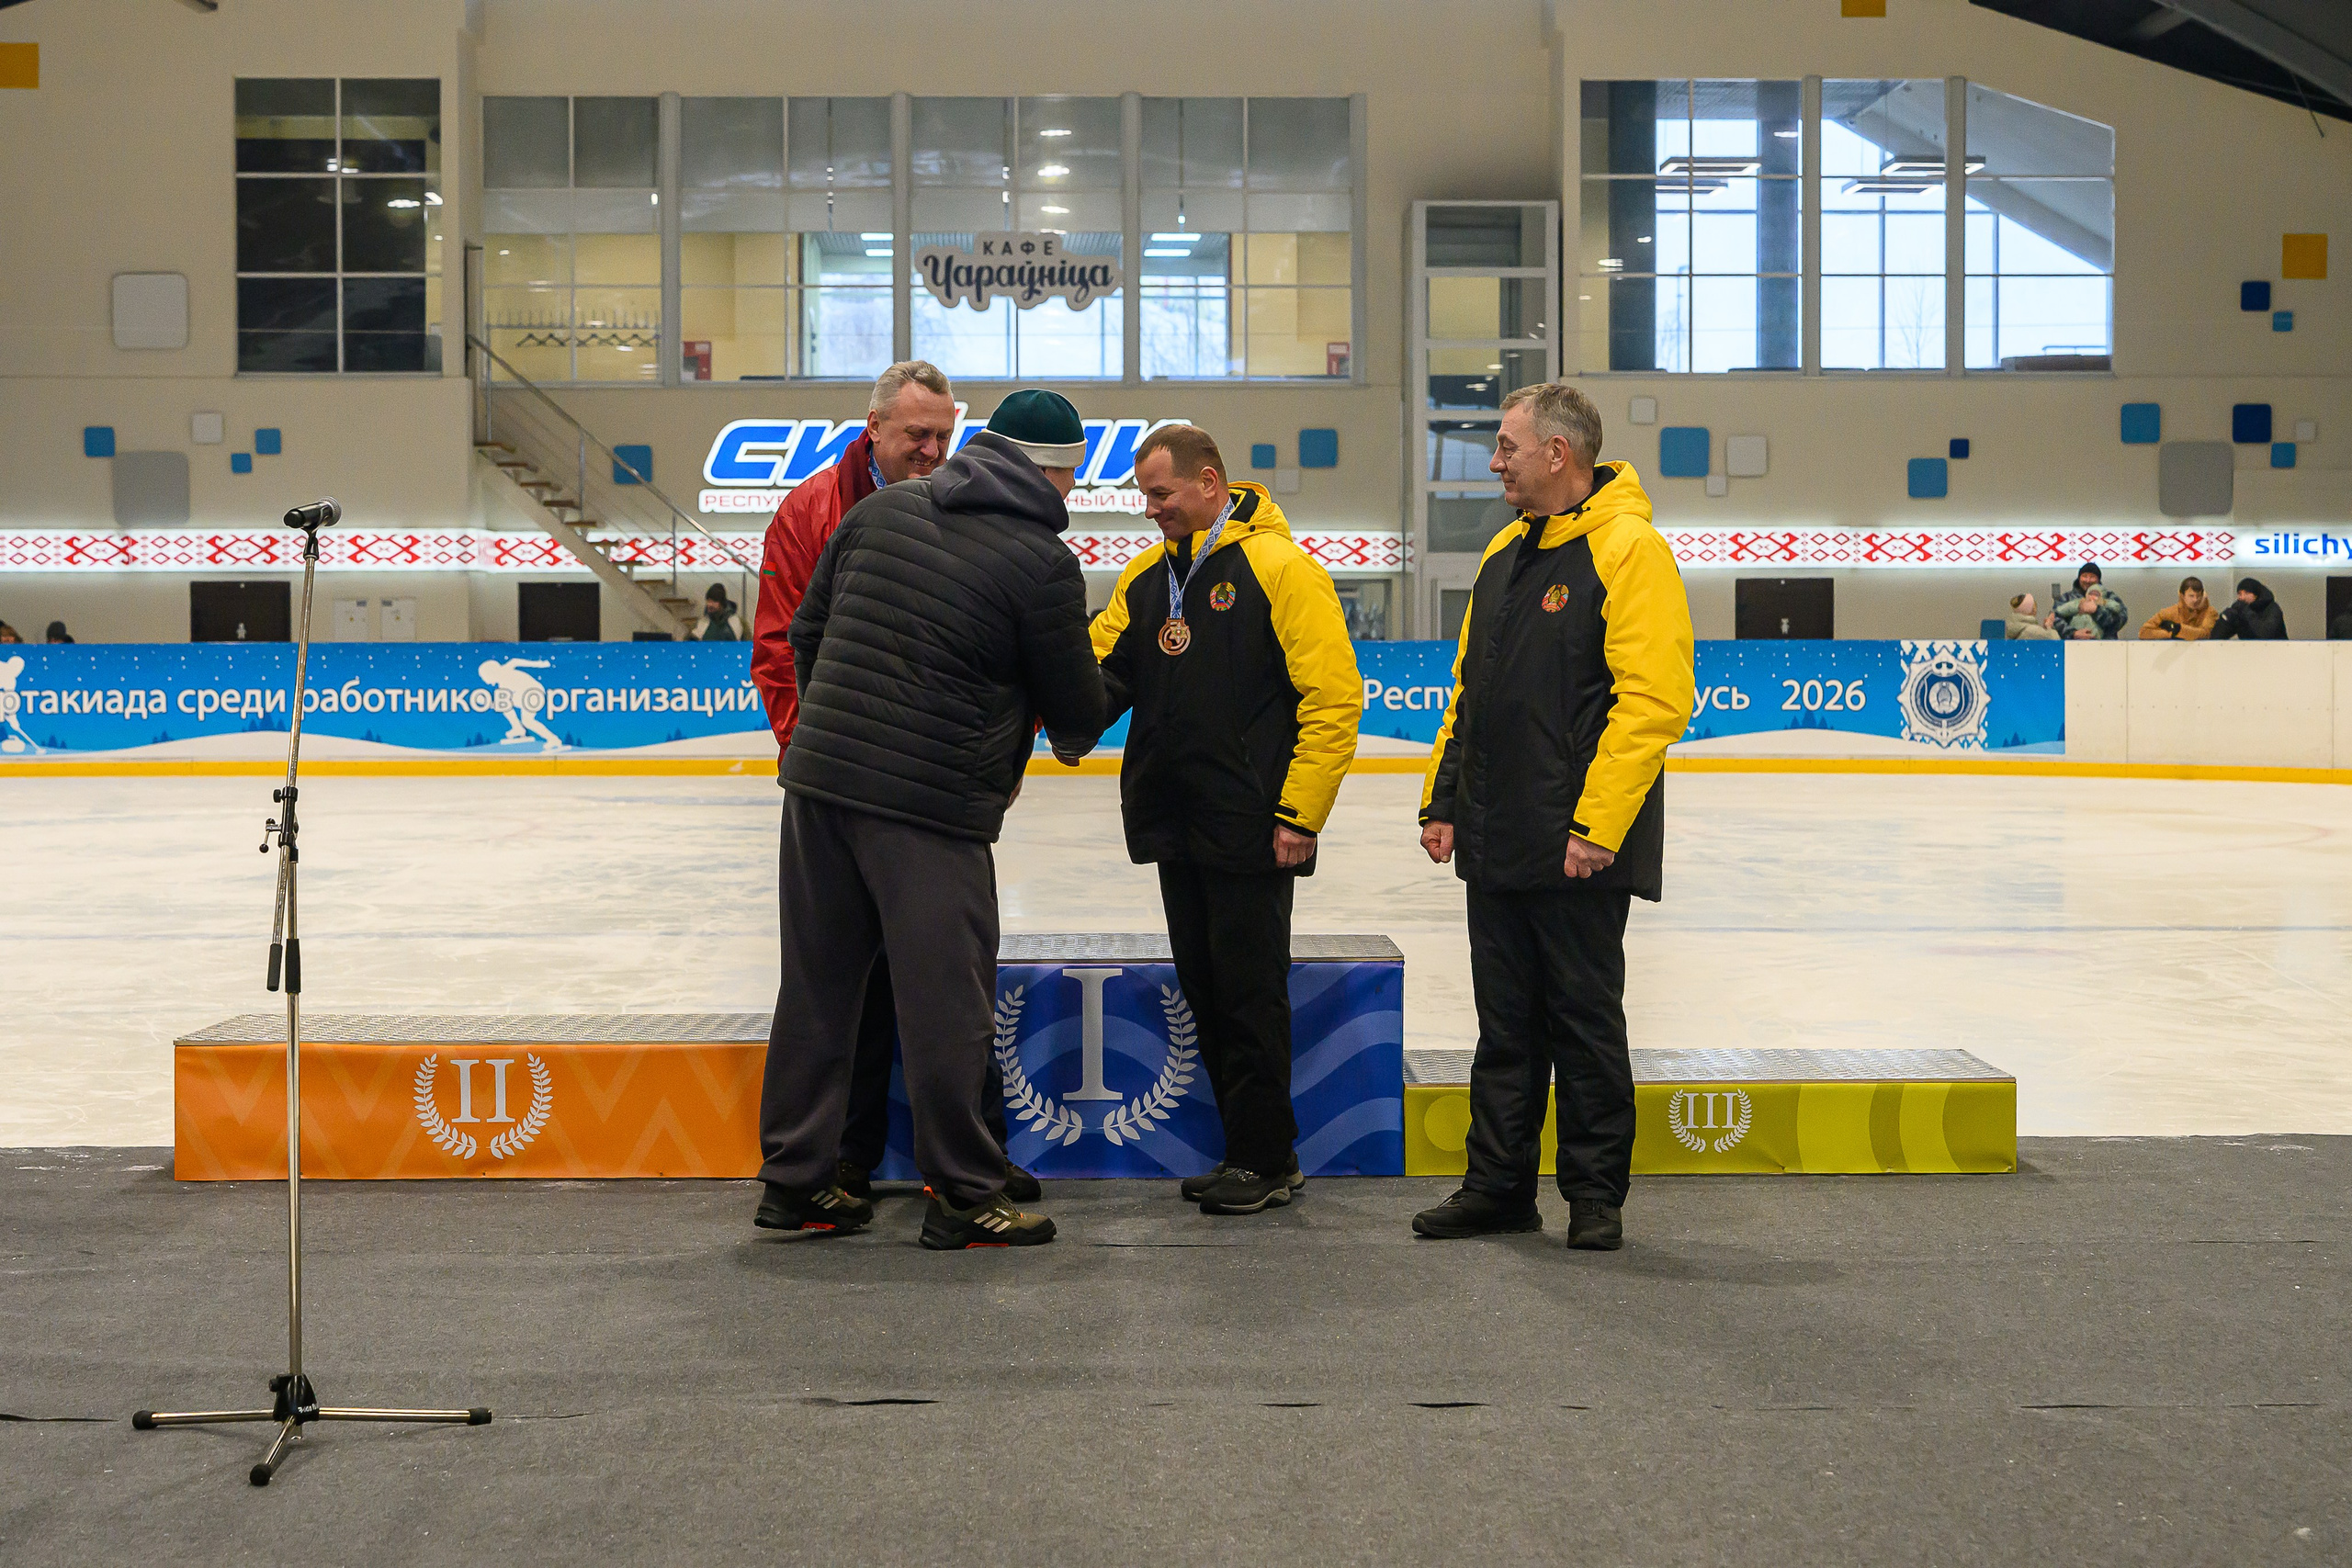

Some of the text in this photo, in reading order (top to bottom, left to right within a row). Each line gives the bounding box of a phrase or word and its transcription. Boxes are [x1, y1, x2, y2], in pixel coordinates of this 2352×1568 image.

[982, 240, 1054, 256] КАФЕ
[923, 254, 1114, 303] Чараўніца
[1066, 491, 1115, 507] НЫЙ
[176, 688, 286, 722] среди
[300, 678, 514, 721] работников
[521, 679, 759, 721] организаций
[1691, 685, 1751, 718] усь
[1781, 678, 1867, 712] 2026
[1062, 967, 1123, 1100] I
[449, 1058, 516, 1123] II
[1682, 1092, 1739, 1129] III
